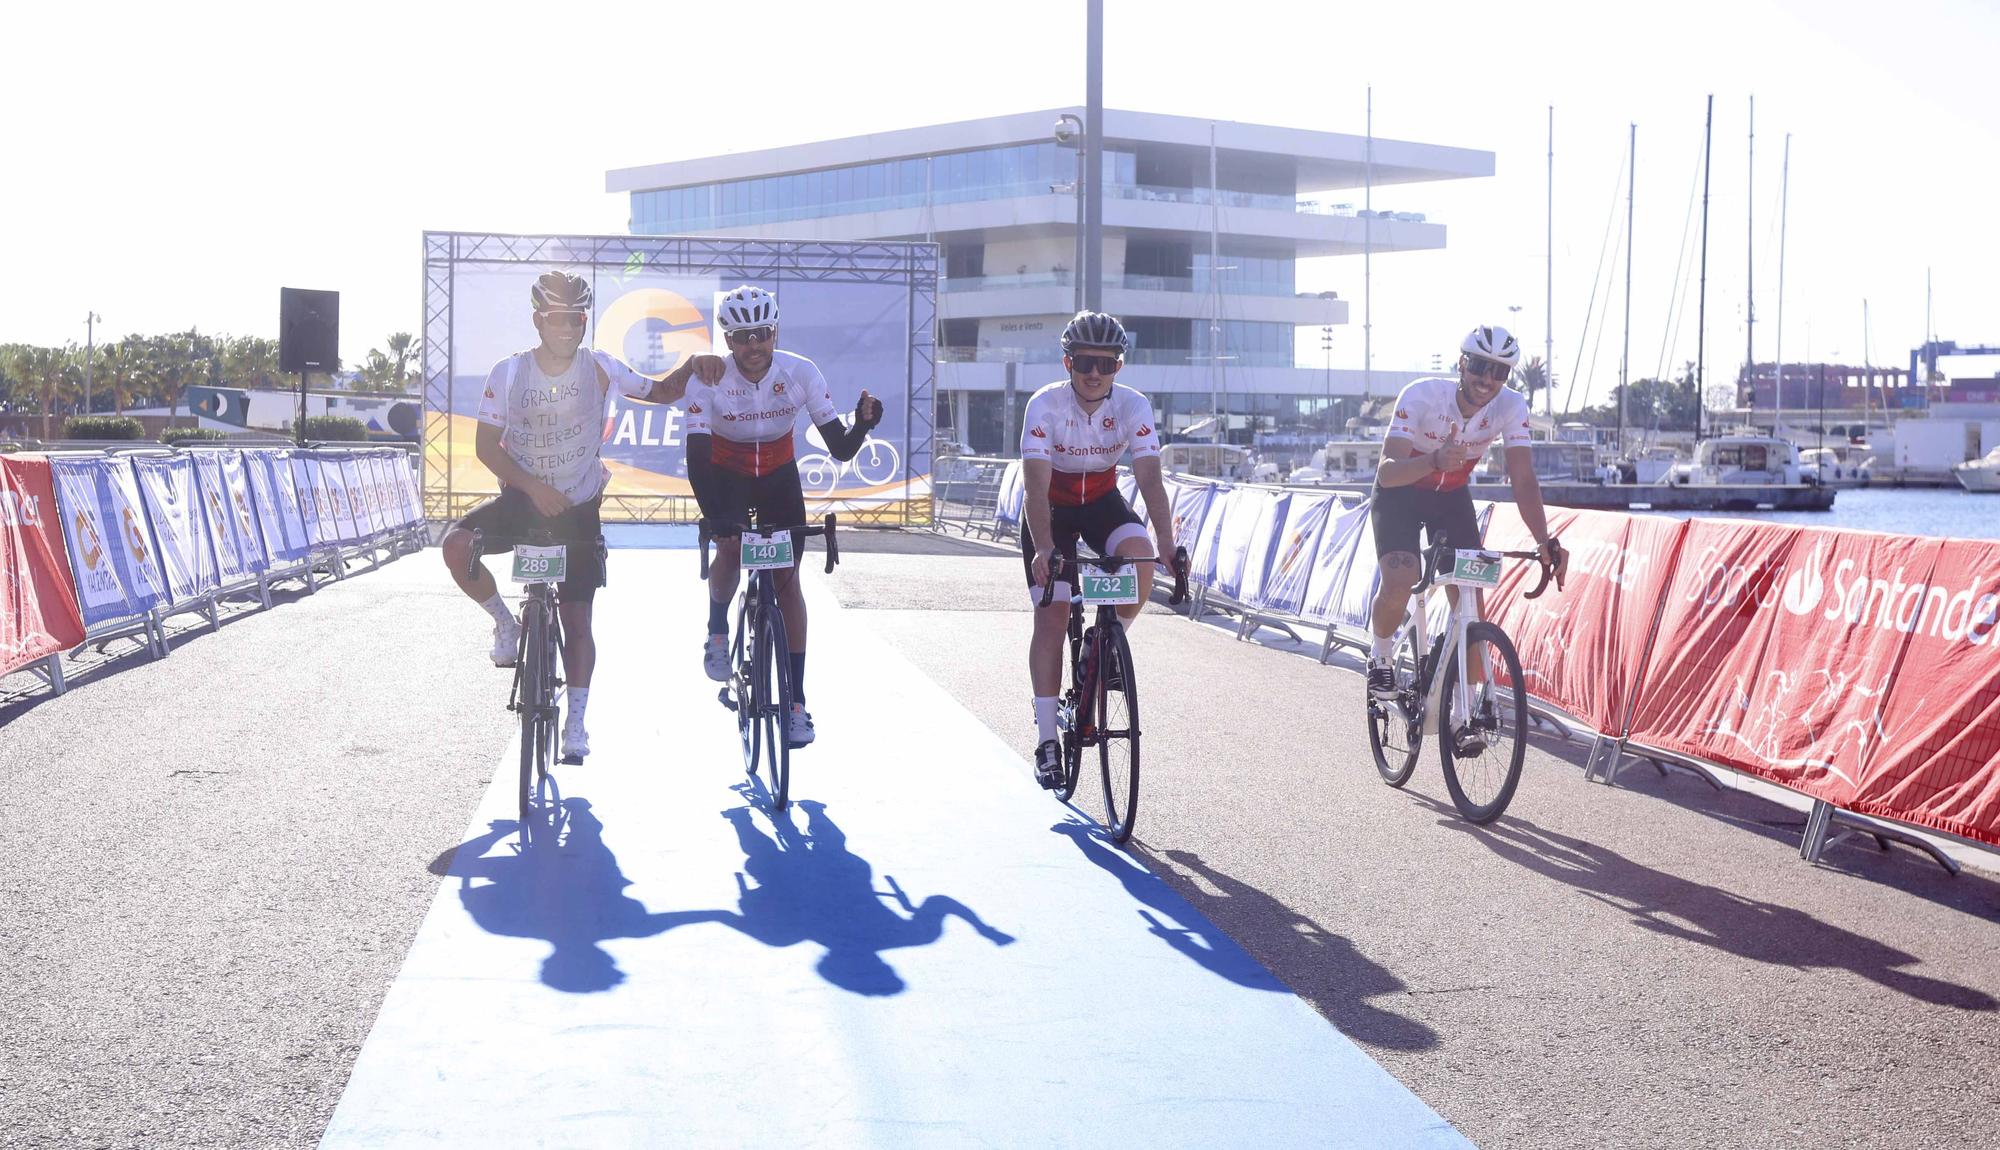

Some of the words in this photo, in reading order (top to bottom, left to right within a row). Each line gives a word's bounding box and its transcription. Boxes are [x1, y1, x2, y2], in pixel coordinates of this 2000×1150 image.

[739, 404, 796, 421] Santander
[750, 545, 777, 559] 140
[520, 558, 549, 572] 289
[1462, 560, 1489, 576] 457
[1091, 577, 1121, 592] 732
[1824, 557, 2000, 646] Santande
